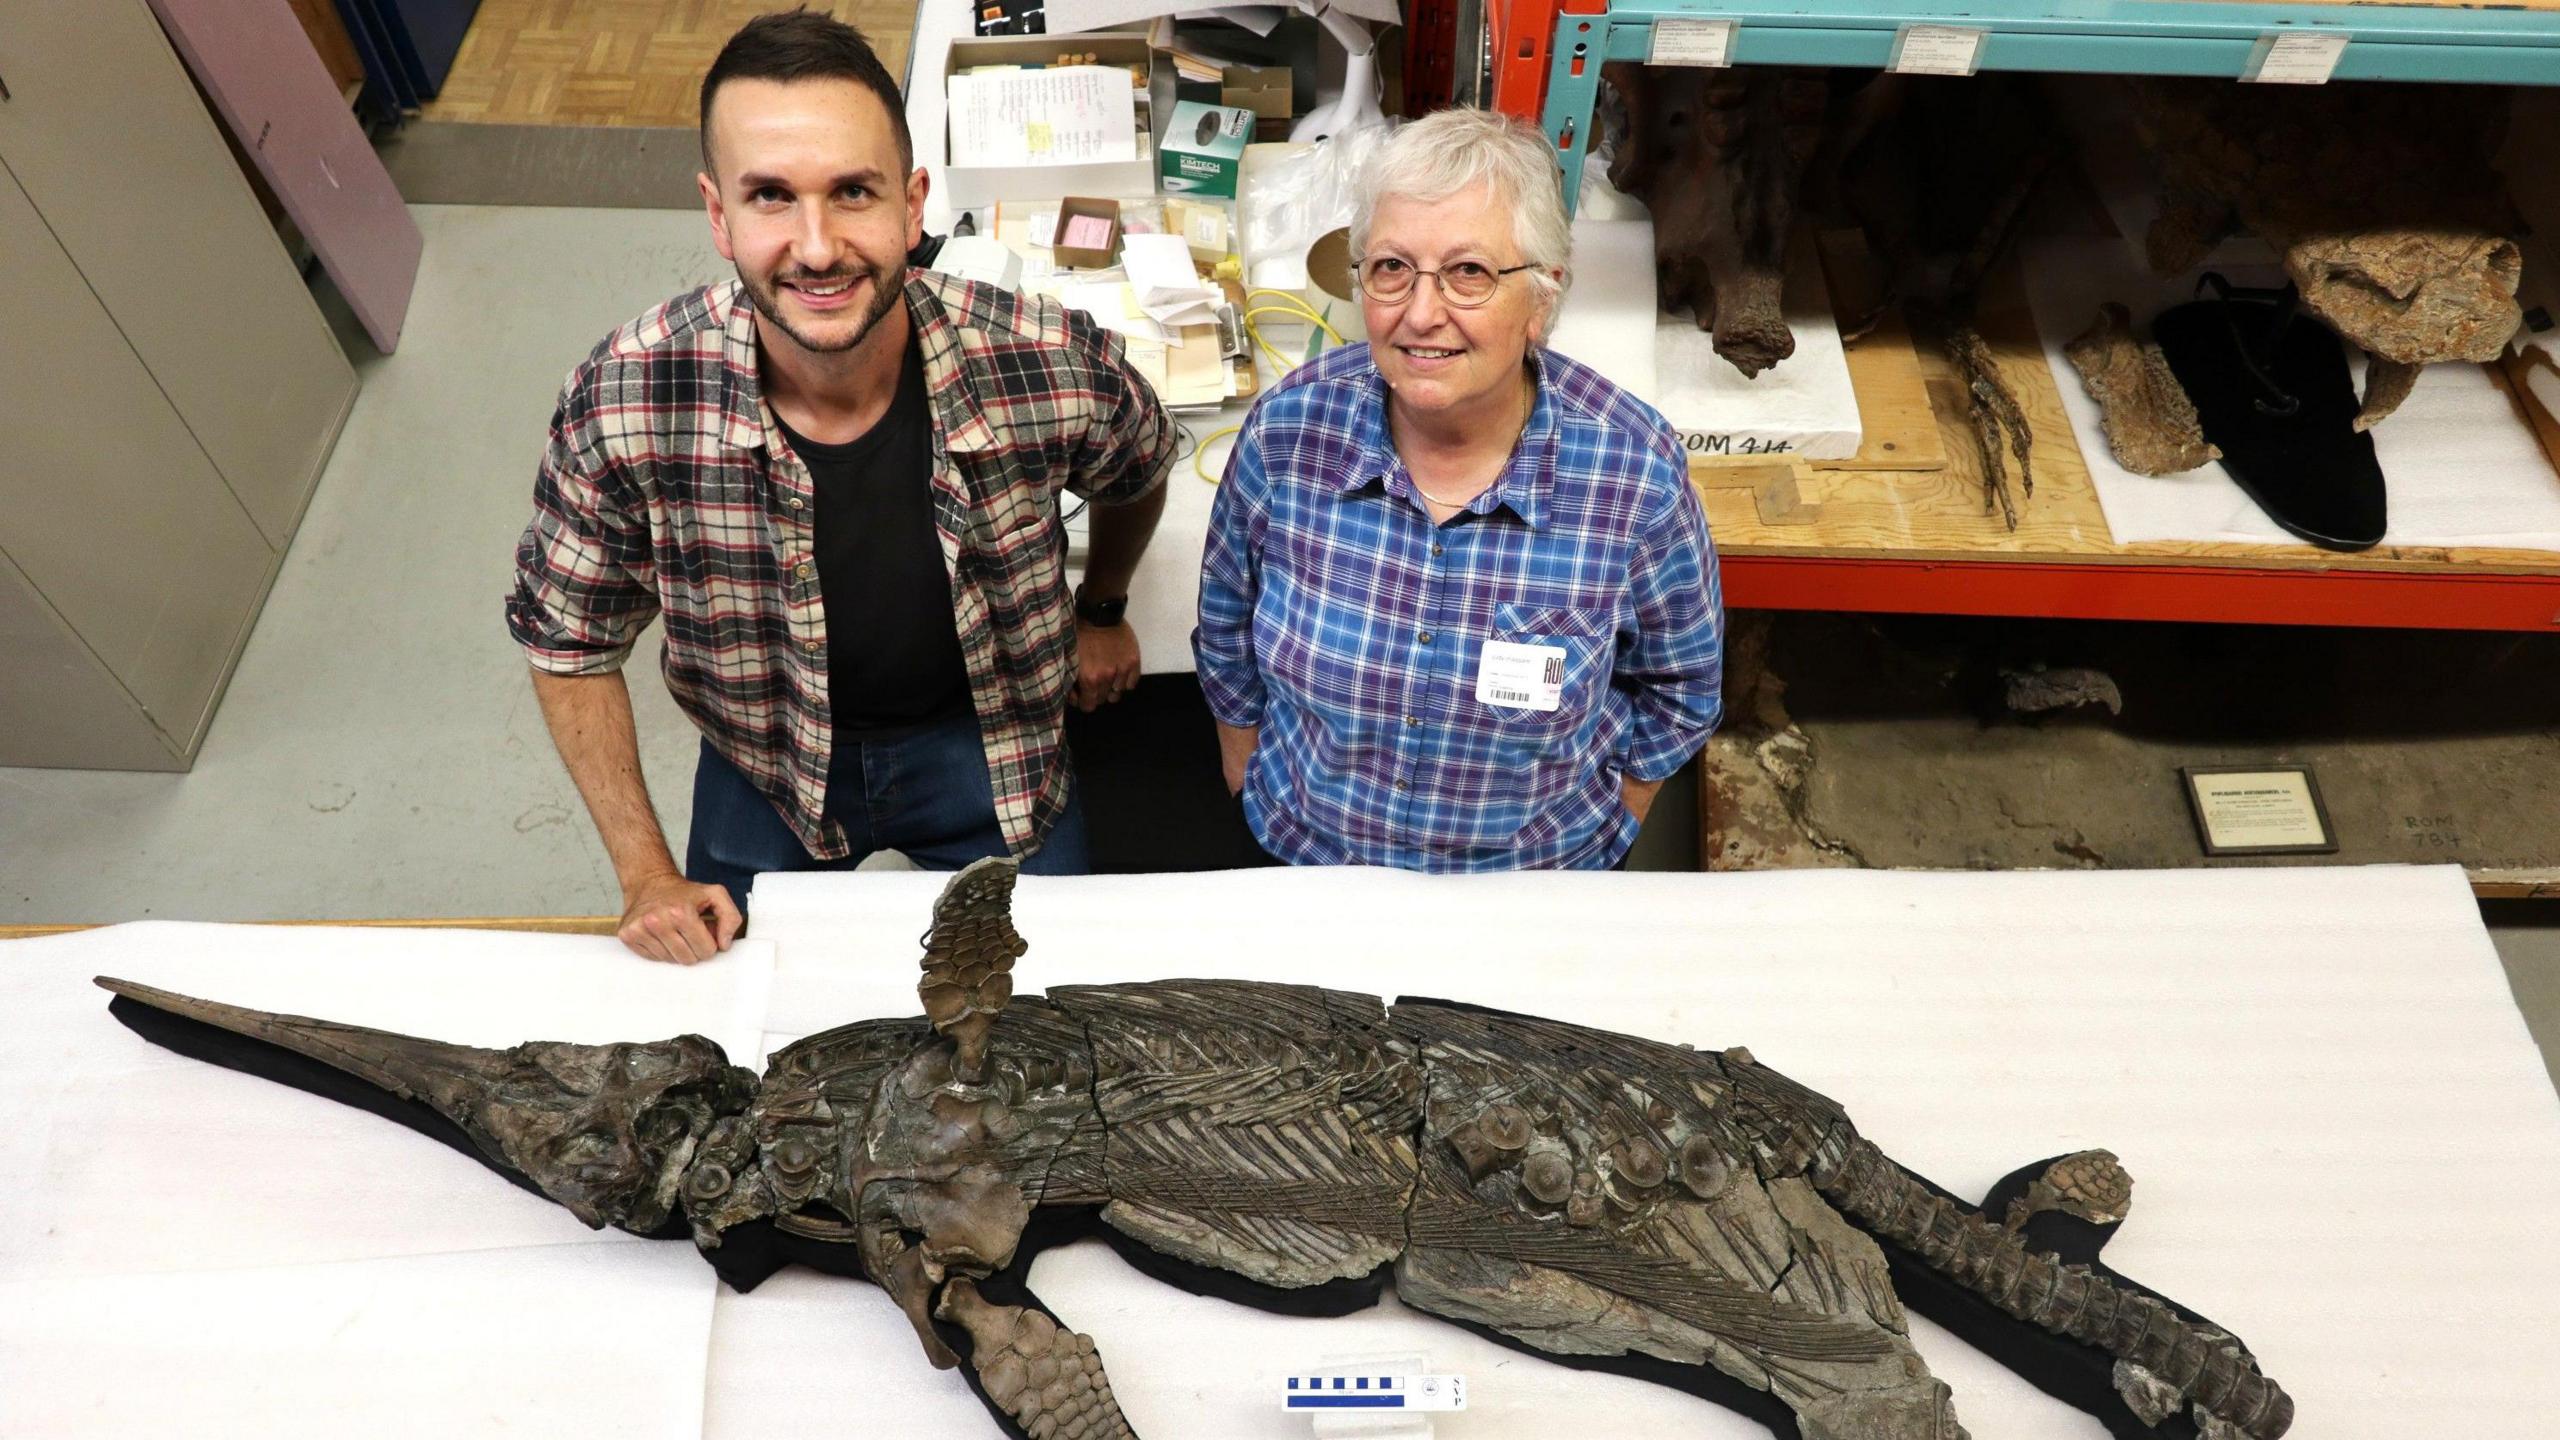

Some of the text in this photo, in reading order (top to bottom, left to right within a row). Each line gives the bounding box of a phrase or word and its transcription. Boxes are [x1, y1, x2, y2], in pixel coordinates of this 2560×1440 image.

[1180, 159, 1220, 171] KIMTECH
[1738, 437, 1793, 454] 414
[2405, 813, 2454, 829] ROM
